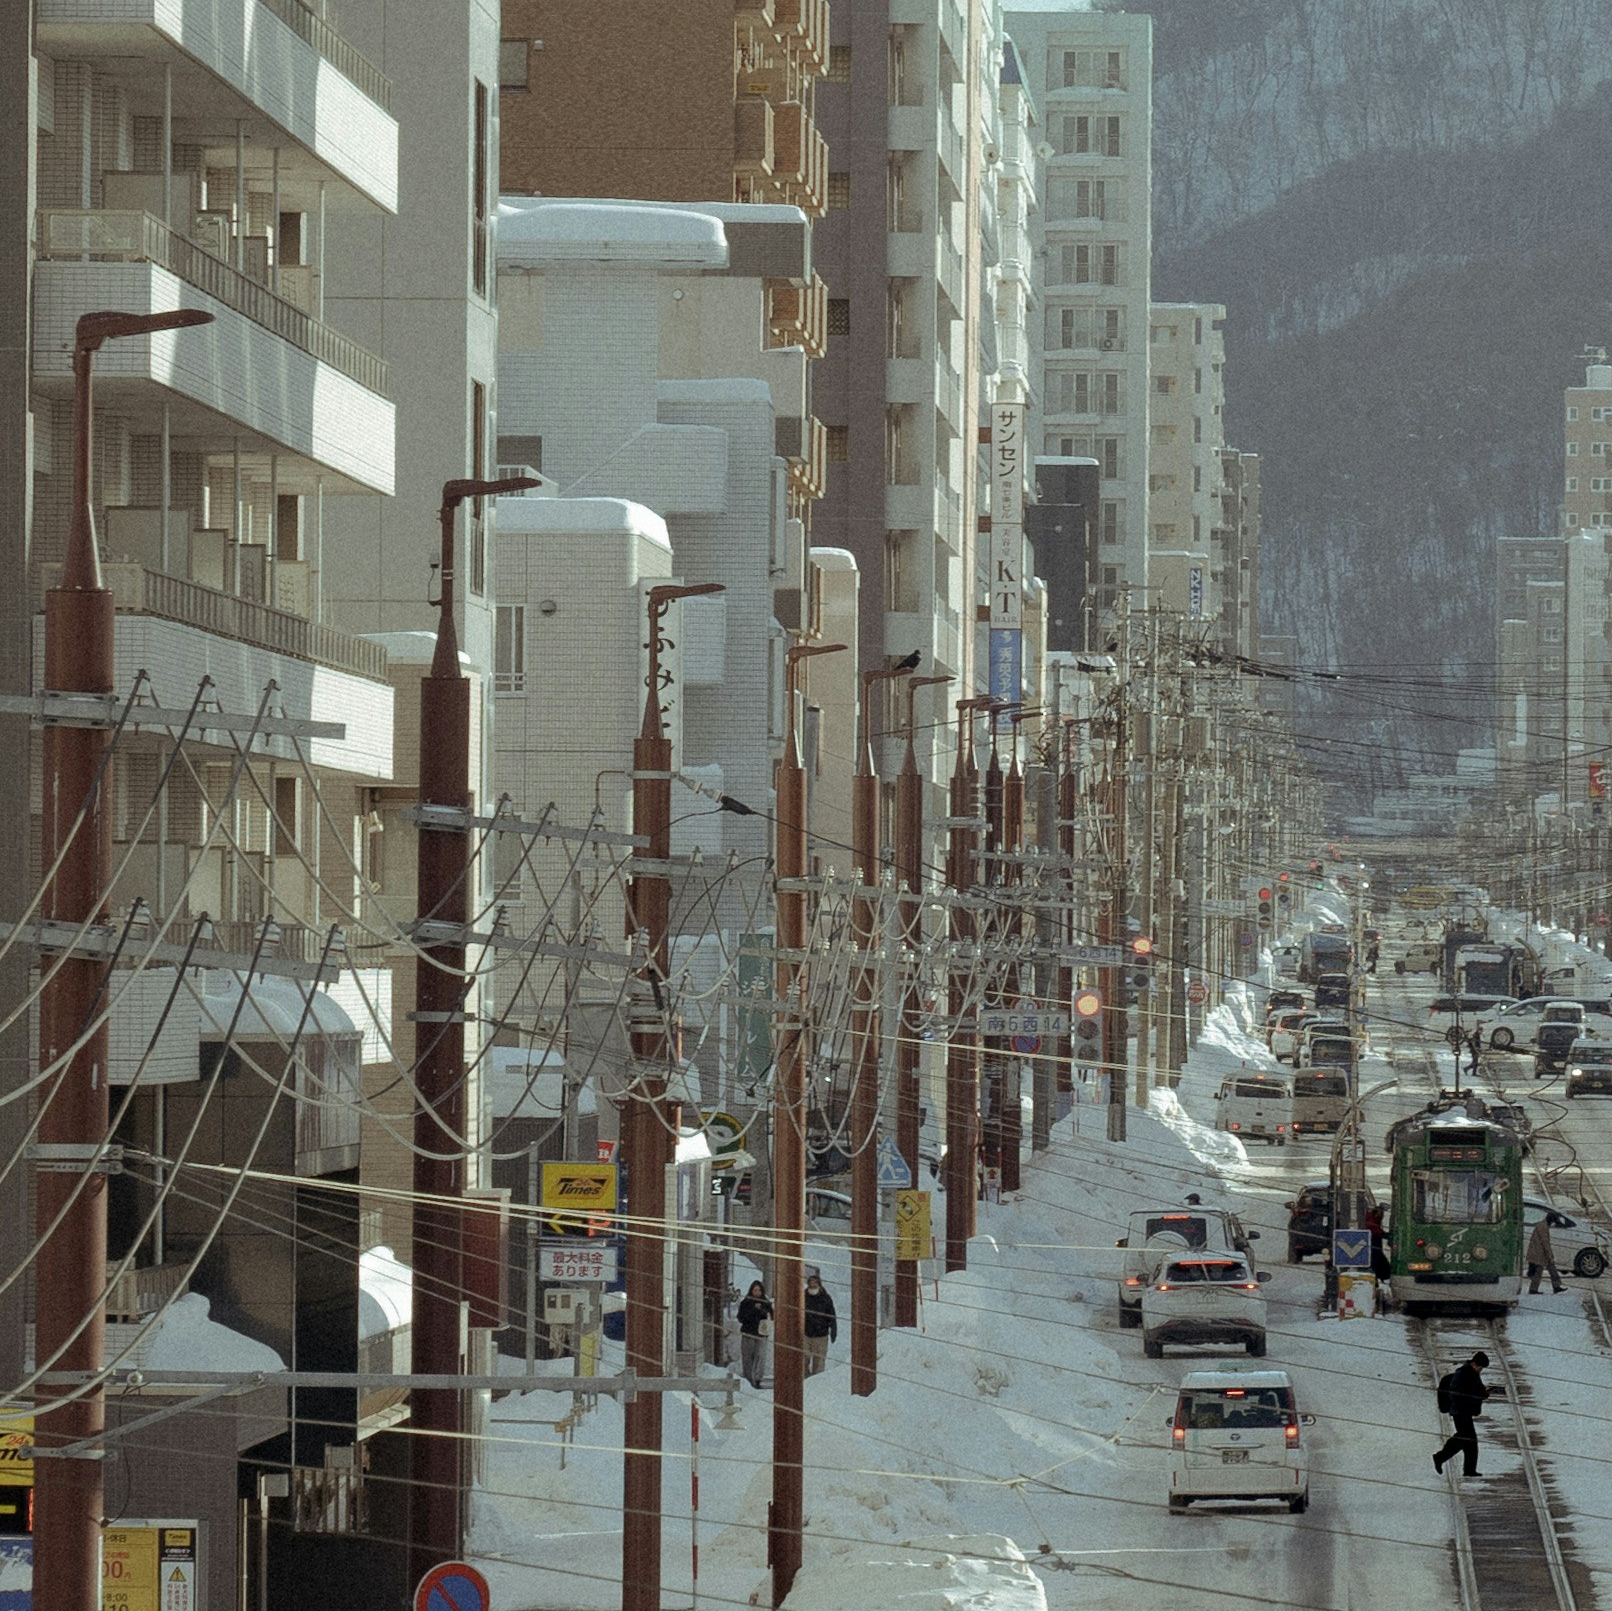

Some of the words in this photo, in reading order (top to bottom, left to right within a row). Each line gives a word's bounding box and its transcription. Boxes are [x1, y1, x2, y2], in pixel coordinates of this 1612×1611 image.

[998, 411, 1017, 477] サンセン
[988, 1016, 1061, 1033] 南5西14
[558, 1178, 601, 1196] Times
[552, 1252, 604, 1264] 最大料金
[1443, 1252, 1472, 1264] 212
[552, 1265, 602, 1277] あります
